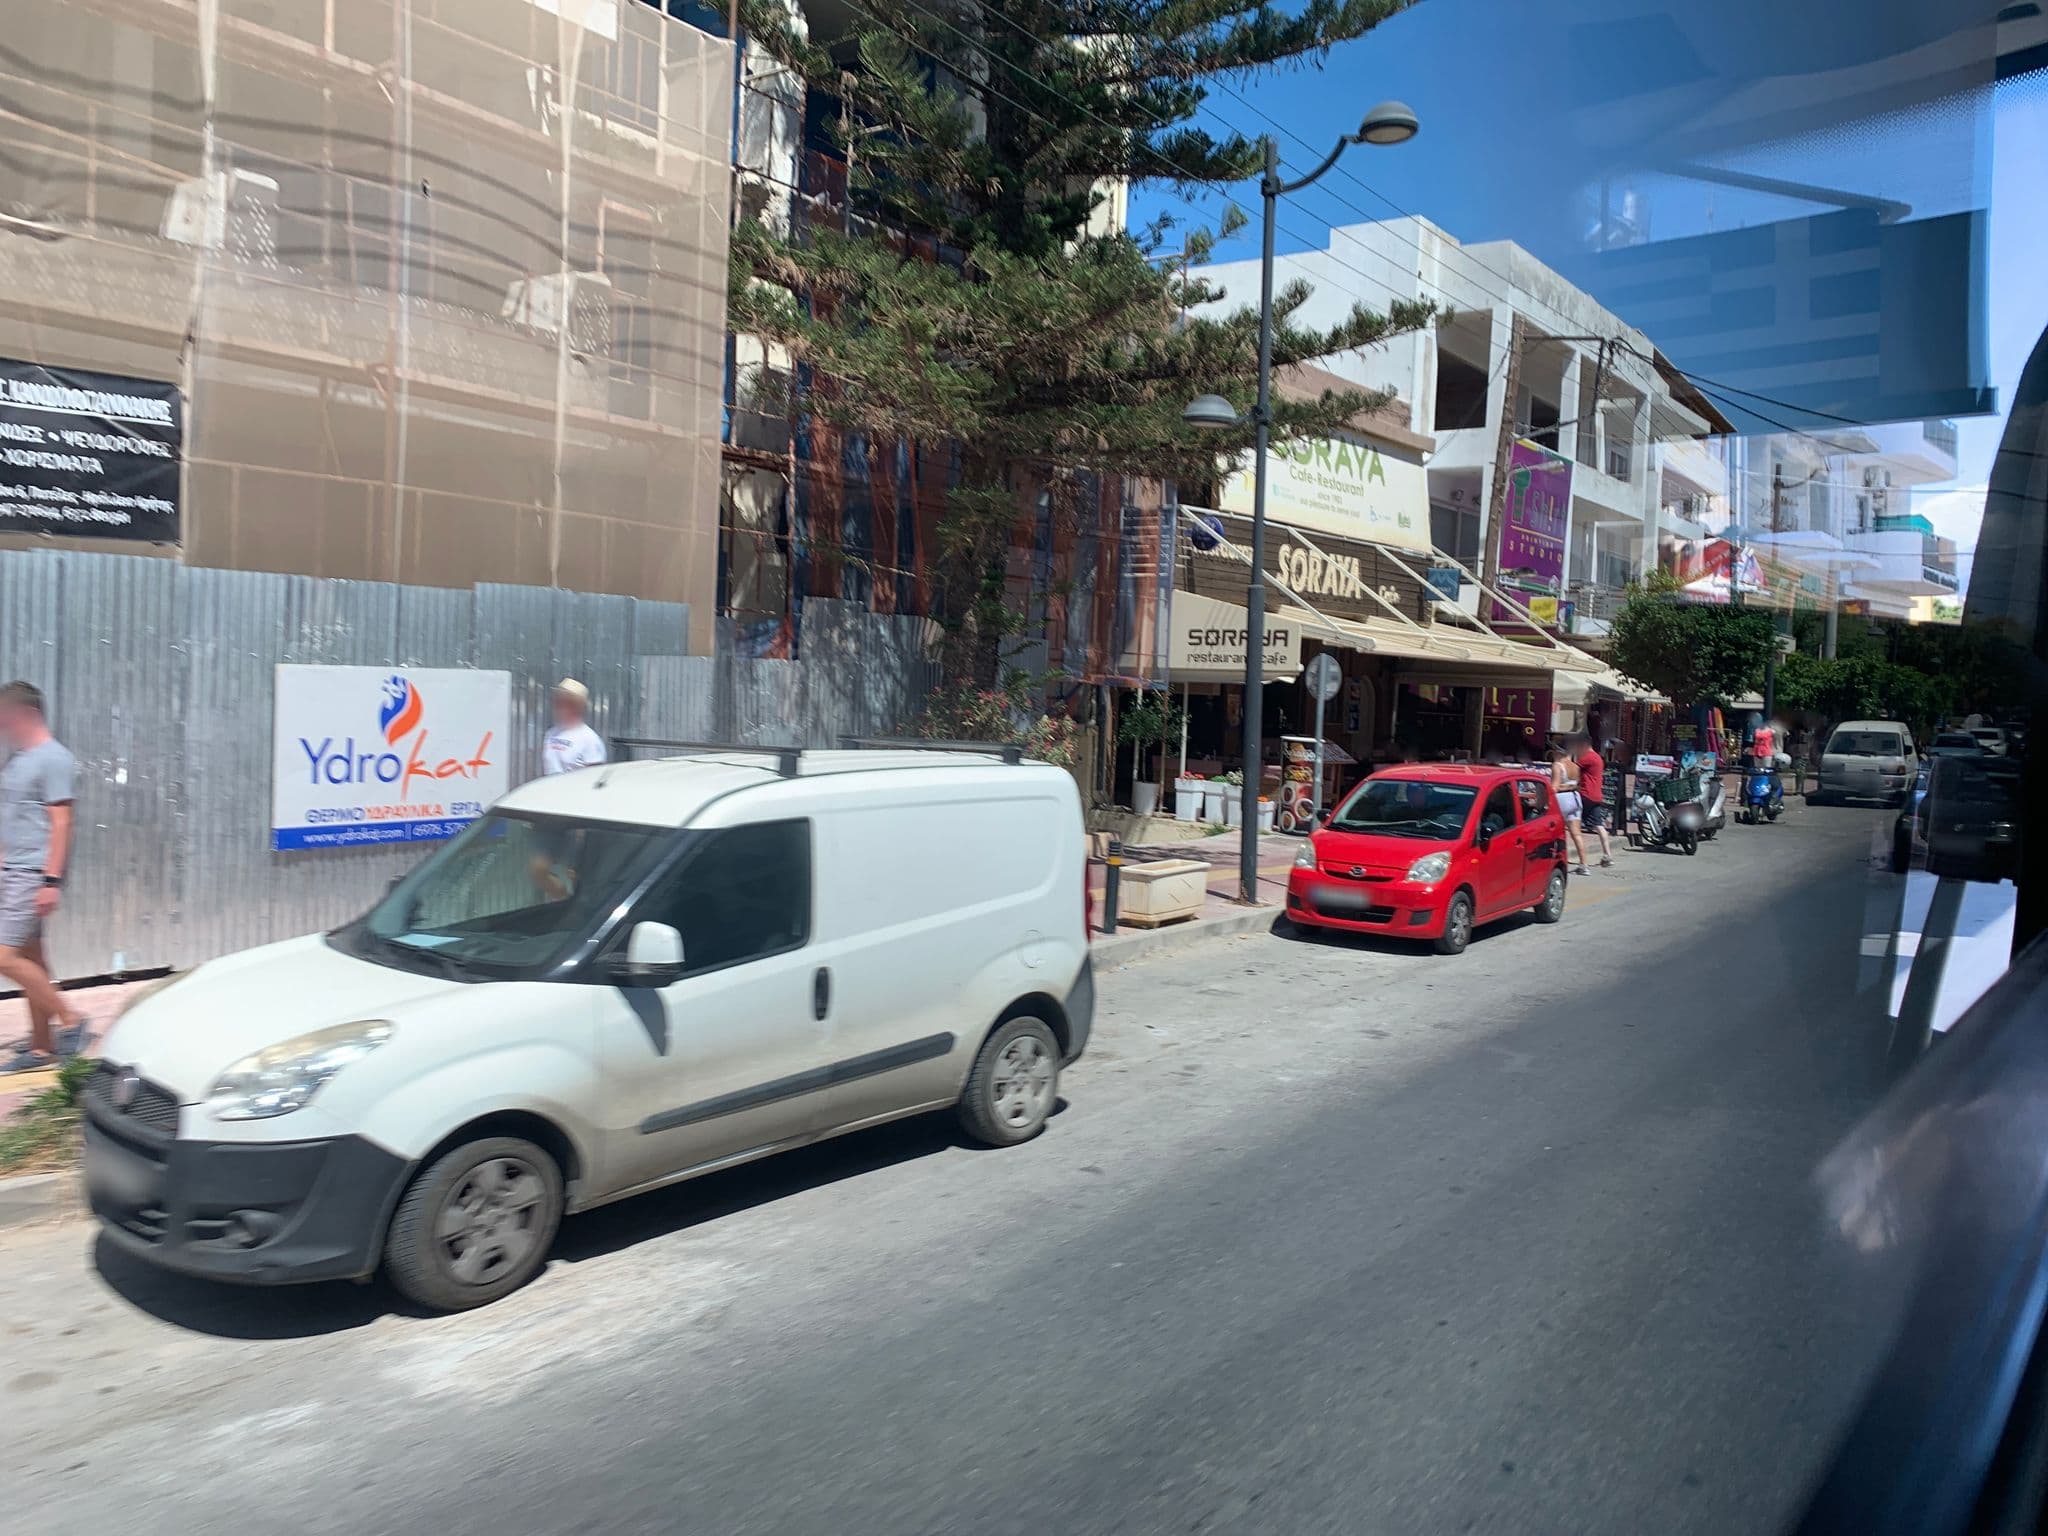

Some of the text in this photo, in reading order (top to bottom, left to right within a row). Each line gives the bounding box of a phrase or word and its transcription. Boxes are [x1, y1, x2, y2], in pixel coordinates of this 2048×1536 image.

[1276, 543, 1362, 600] SORAYA
[1187, 651, 1248, 664] restauran
[299, 728, 493, 801] Ydrokat
